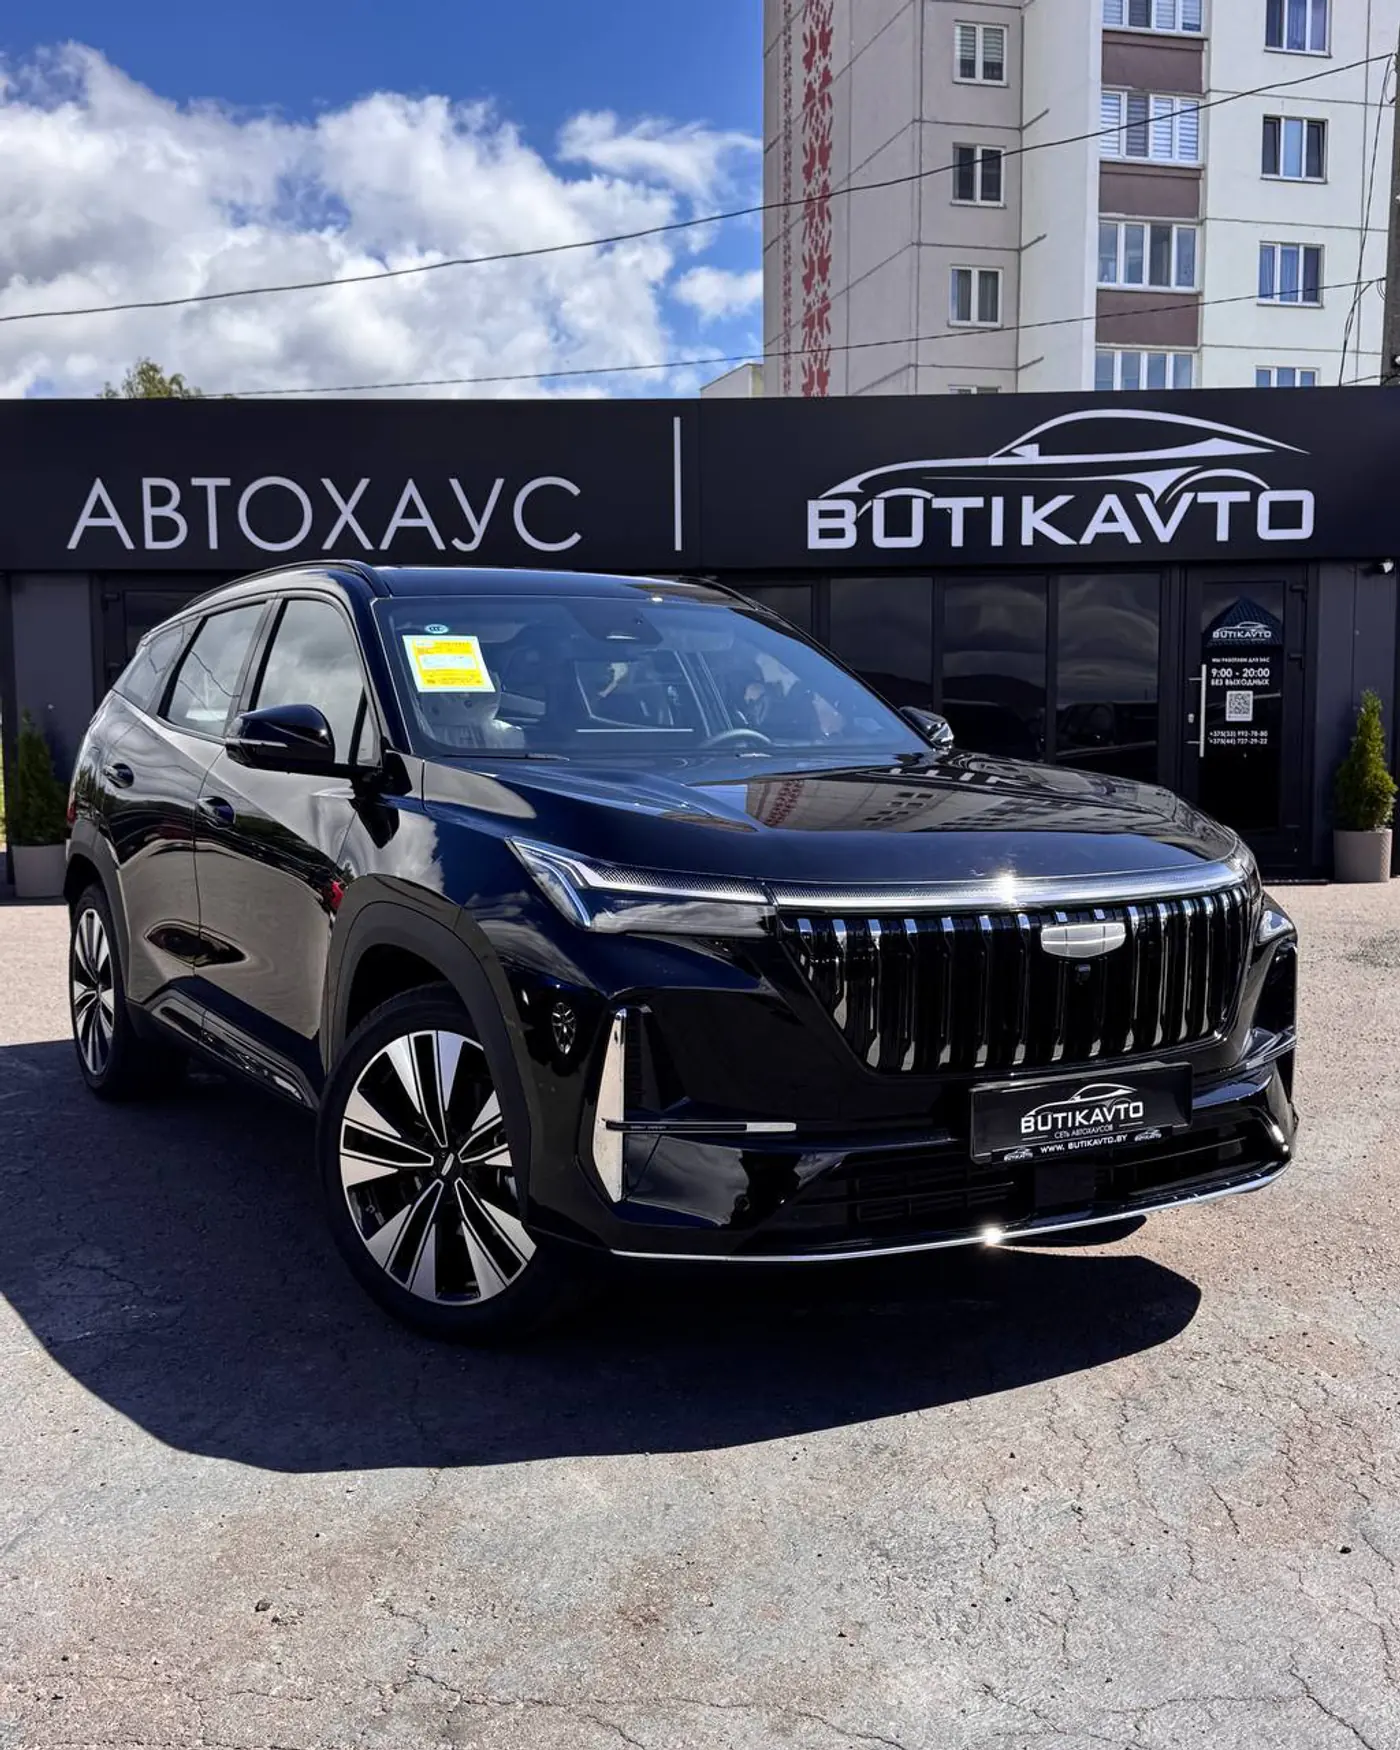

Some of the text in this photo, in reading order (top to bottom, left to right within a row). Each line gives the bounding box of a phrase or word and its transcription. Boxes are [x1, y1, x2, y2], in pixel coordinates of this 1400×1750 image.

[66, 475, 582, 553] АВТОХАУС
[806, 488, 1315, 550] BUTIKAVTO
[1212, 630, 1271, 639] BUTIKAVTO
[1211, 667, 1233, 678] 9:00
[1242, 667, 1270, 678] 20:00
[1211, 678, 1270, 686] БЕЗ ВЫХОДНЫХ
[1020, 1101, 1144, 1134] BUTIKAVTO
[1054, 1123, 1114, 1139] СЕТЬ АВТОХАУСОВ
[1040, 1134, 1128, 1154] WWW. BUTIKAVTO.BY
